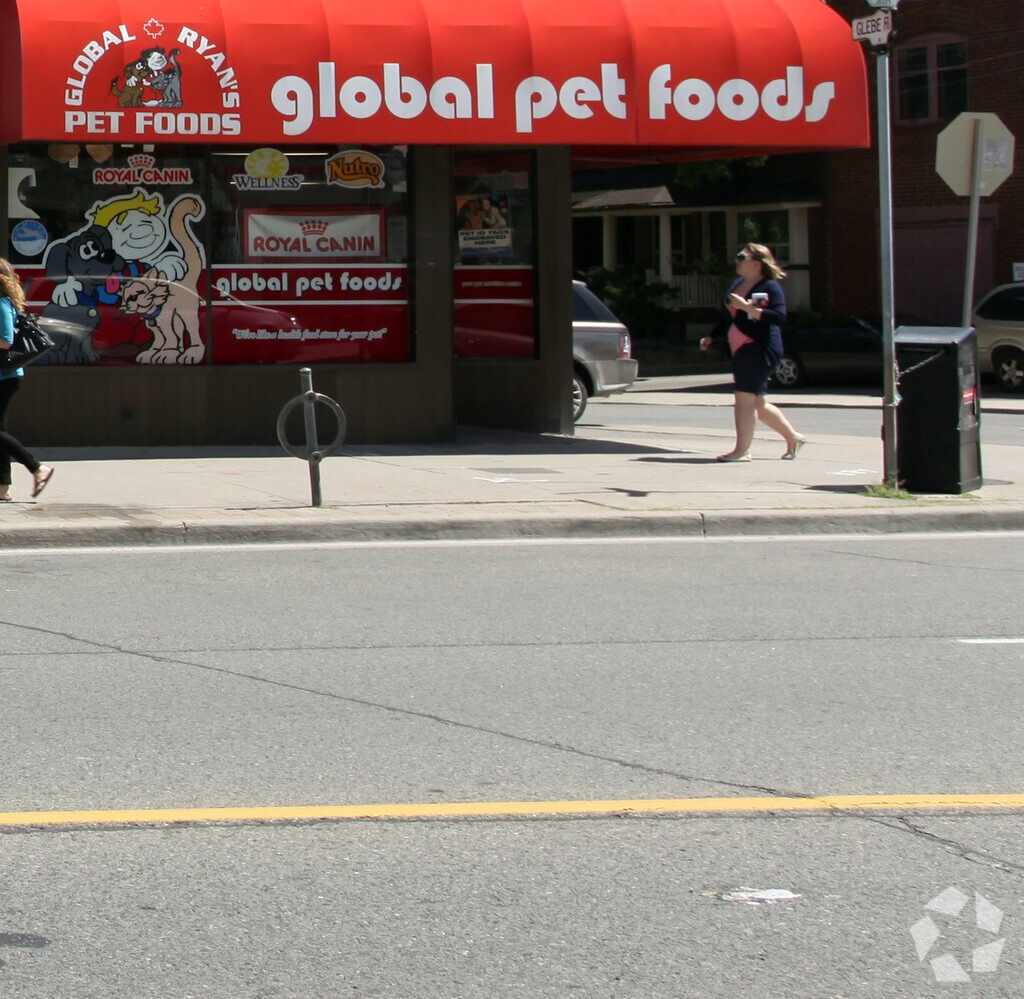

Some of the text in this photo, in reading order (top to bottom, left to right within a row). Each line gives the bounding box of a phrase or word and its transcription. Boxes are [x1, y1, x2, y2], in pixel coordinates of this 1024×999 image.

[856, 18, 881, 36] GLEBE
[64, 24, 241, 109] GLOBAL RYAN'S
[270, 61, 835, 137] global pet foods
[64, 111, 242, 136] PET FOODS
[93, 169, 190, 184] ROYAL CANIN
[234, 175, 302, 189] WELLNESS
[328, 156, 382, 185] Nutro
[253, 235, 375, 252] ROYAL CANIN
[216, 272, 402, 297] global pet foods
